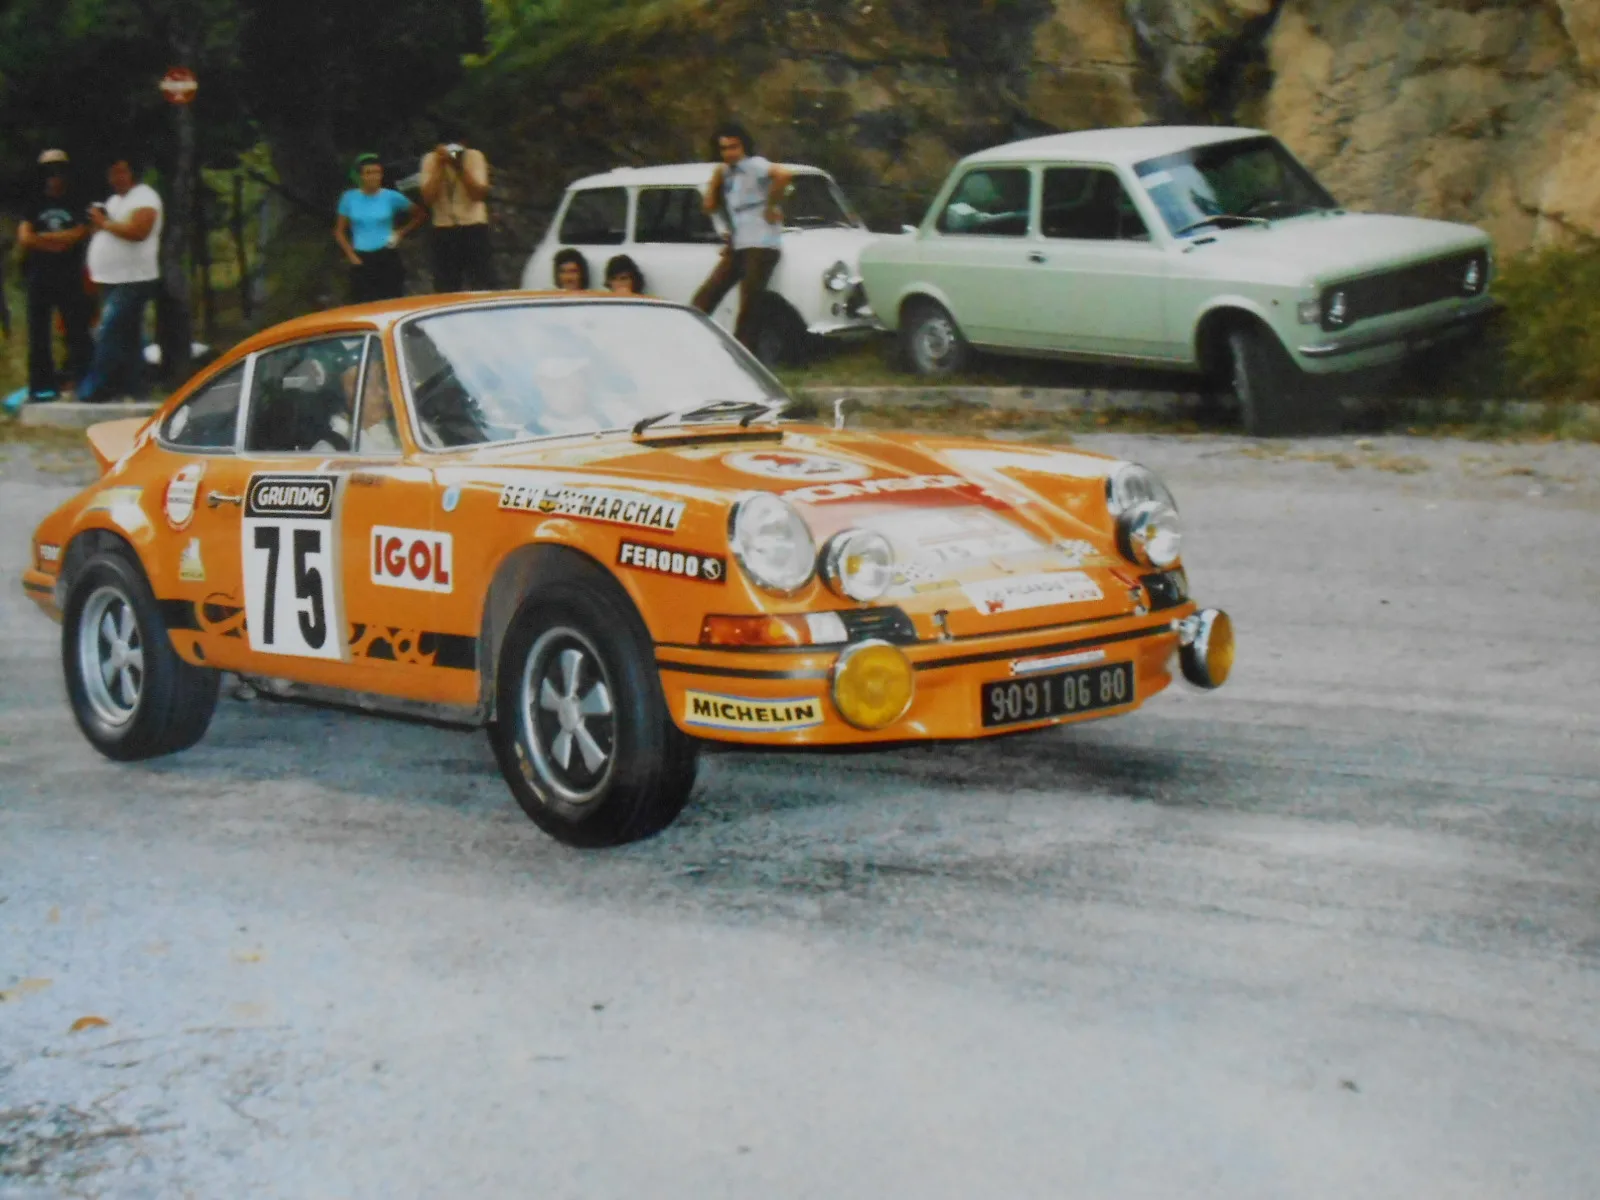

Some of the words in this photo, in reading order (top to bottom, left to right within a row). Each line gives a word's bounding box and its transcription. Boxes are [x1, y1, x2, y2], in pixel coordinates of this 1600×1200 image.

[258, 486, 325, 507] GRUNDIG
[579, 495, 675, 529] MARCHAL
[375, 534, 449, 585] IGOL
[620, 543, 699, 577] FERODO
[254, 526, 327, 650] 75
[693, 697, 814, 722] MICHELIN
[991, 679, 1051, 721] 9091
[1064, 674, 1091, 709] 06
[1100, 667, 1126, 702] 80
